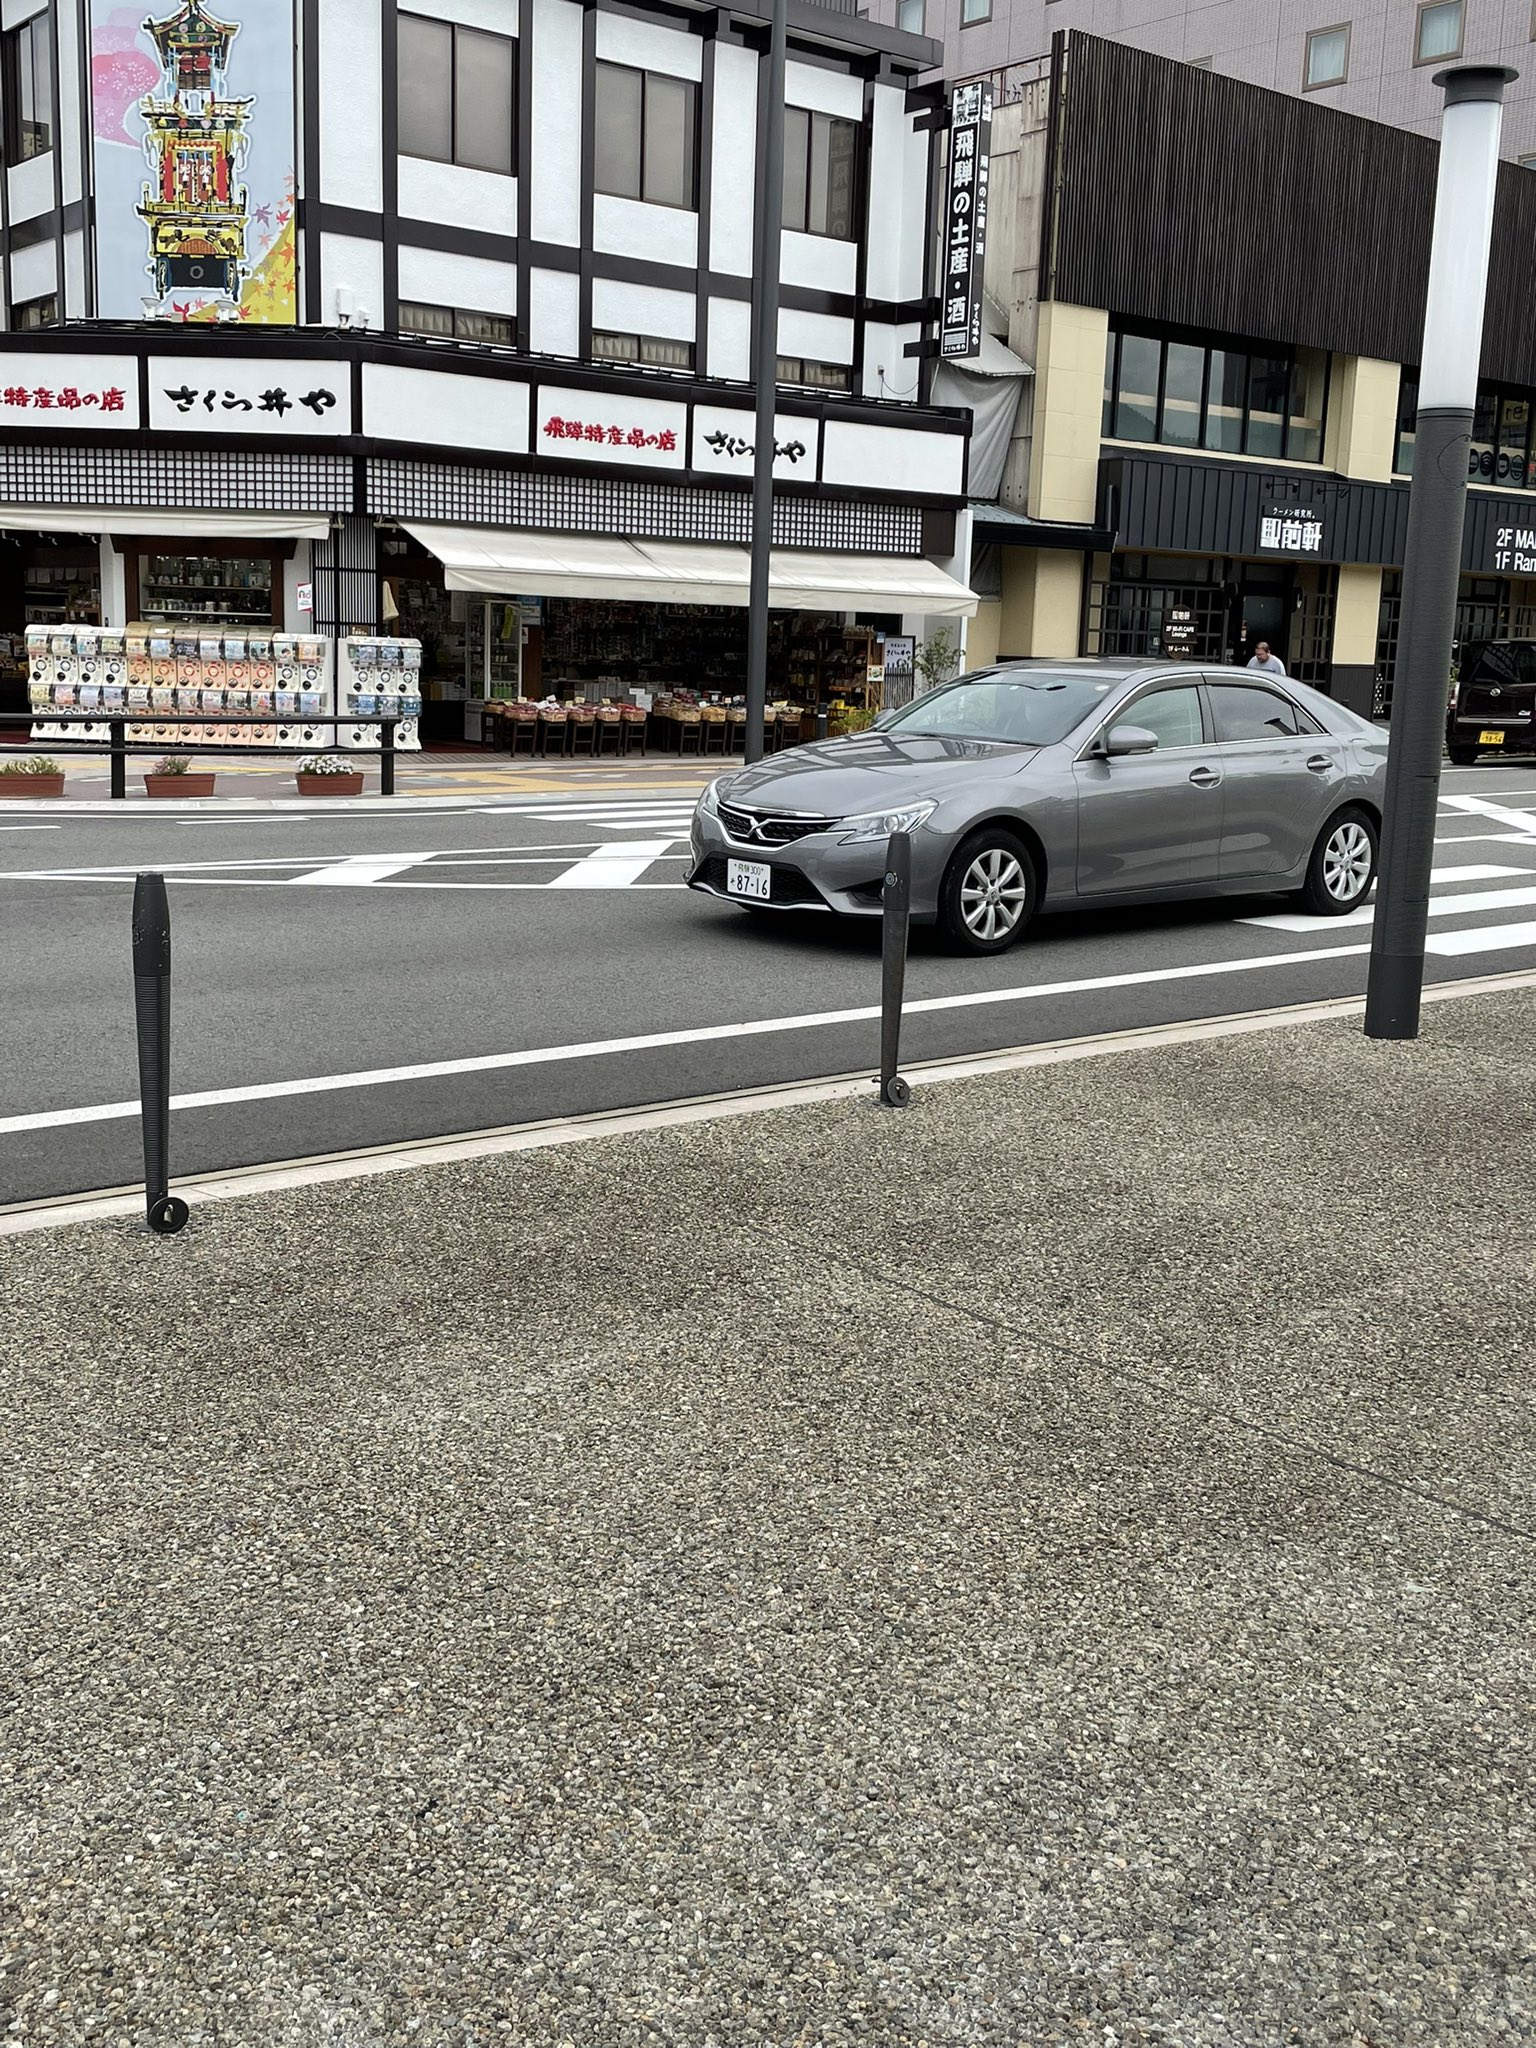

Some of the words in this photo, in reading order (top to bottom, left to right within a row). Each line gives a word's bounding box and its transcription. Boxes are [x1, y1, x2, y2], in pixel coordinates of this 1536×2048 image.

[948, 128, 975, 324] 飛騨の土産・酒
[0, 386, 126, 412] 特産品の店
[1496, 528, 1514, 548] 2F
[1495, 551, 1512, 570] 1F
[736, 874, 768, 896] 87-16
